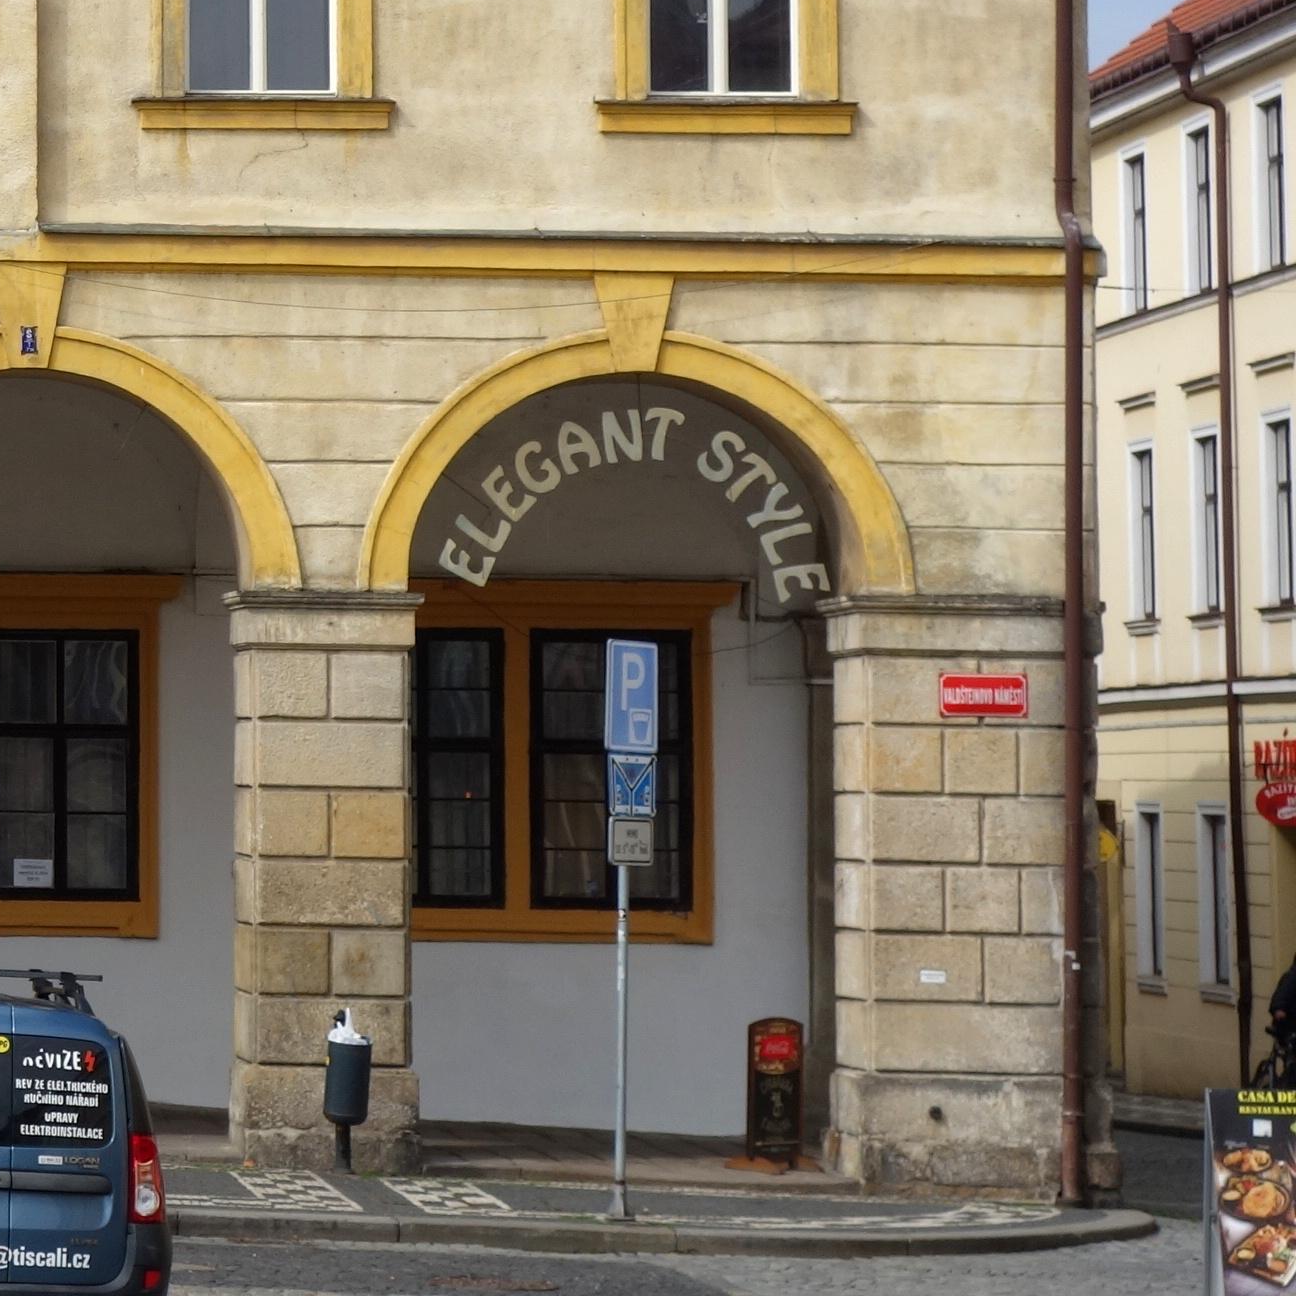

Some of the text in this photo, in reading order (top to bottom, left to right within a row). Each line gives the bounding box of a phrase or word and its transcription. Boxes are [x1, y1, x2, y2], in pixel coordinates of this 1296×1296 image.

[438, 407, 831, 603] ELEGANT STYLE
[621, 652, 646, 711] P
[15, 1078, 45, 1090] REVZE
[1237, 1090, 1275, 1103] CASA
[20, 1124, 104, 1140] ELEKTROINSTALACE
